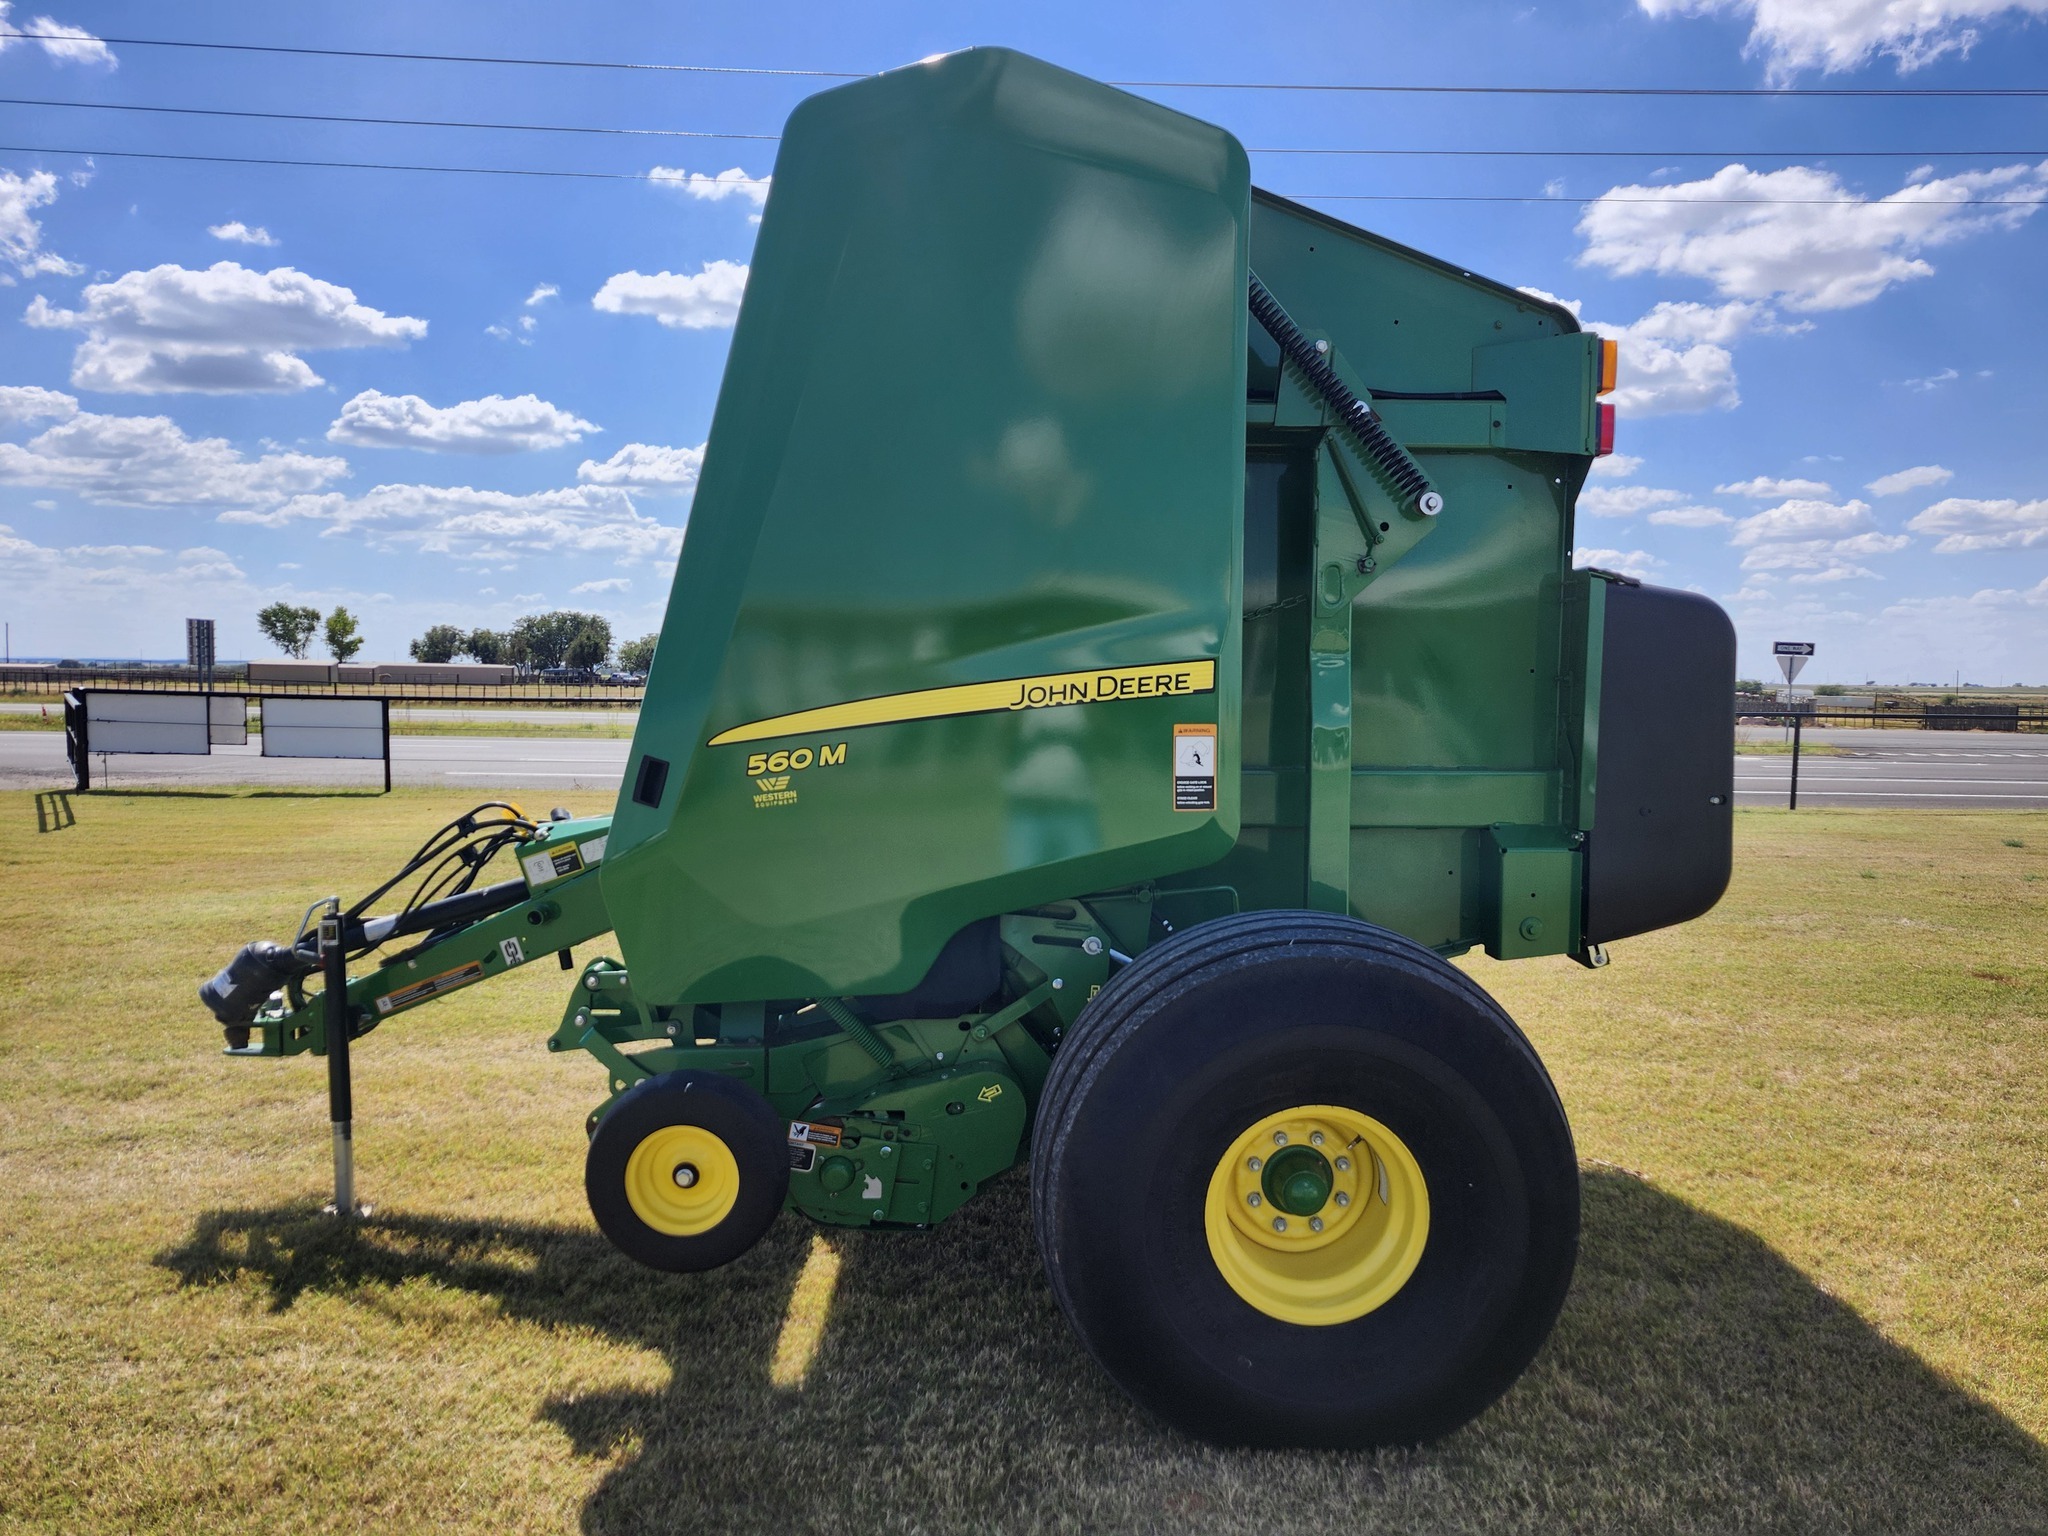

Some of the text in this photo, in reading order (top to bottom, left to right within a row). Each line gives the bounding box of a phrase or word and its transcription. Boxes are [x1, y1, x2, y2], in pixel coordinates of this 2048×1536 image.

[1010, 673, 1191, 706] JOHN DEERE
[746, 742, 848, 777] 560 M
[753, 790, 797, 803] WESTERN
[755, 797, 798, 808] EQUIPMENT
